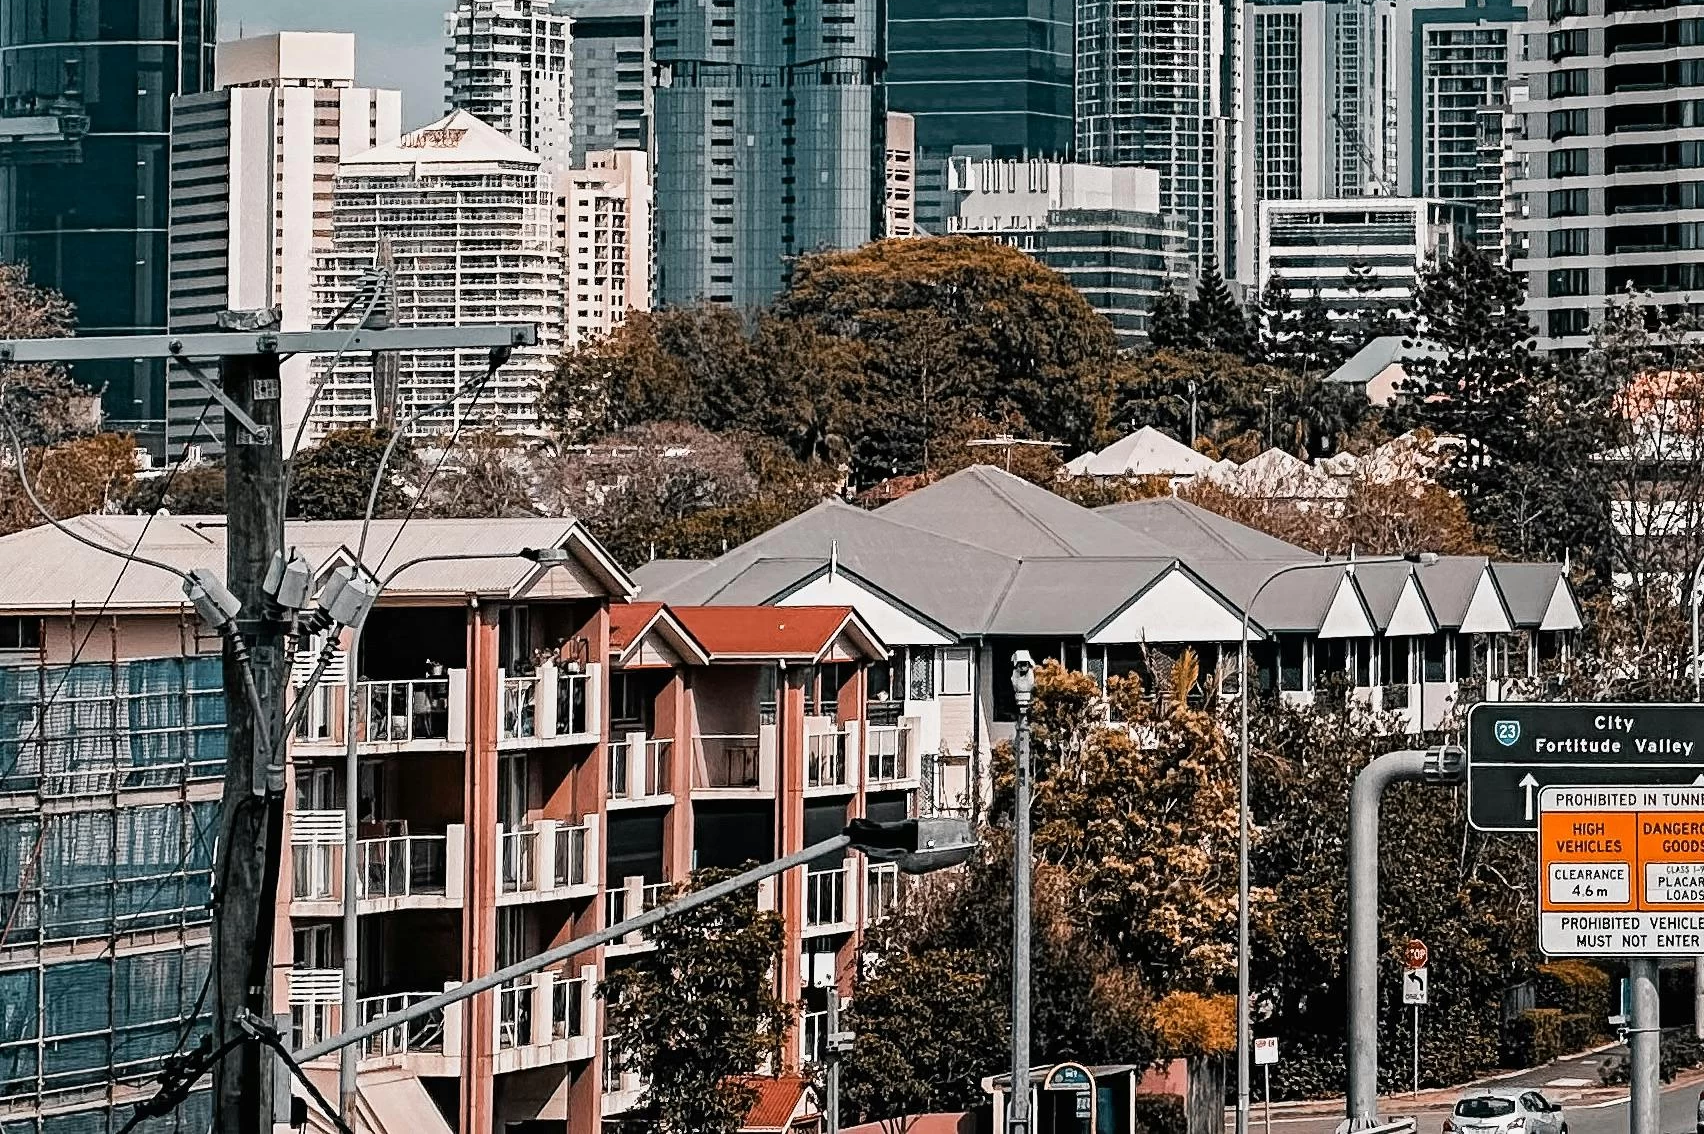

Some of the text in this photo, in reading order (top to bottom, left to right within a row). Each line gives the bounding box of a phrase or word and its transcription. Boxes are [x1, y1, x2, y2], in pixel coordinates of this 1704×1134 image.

[1594, 715, 1635, 733] City
[1499, 725, 1516, 739] 23
[1535, 738, 1694, 756] Fortitude Valley
[1556, 793, 1637, 807] PROHIBITED
[1643, 793, 1657, 806] IN
[1572, 822, 1605, 836] HIGH
[1556, 839, 1622, 853] VEHICLES
[1554, 869, 1625, 881] CLEARANCE
[1666, 866, 1690, 874] CLASS
[1571, 884, 1608, 897] 4.6 m
[1561, 917, 1640, 930] PROHIBITED
[1576, 934, 1700, 948] MUST NOT ENTER
